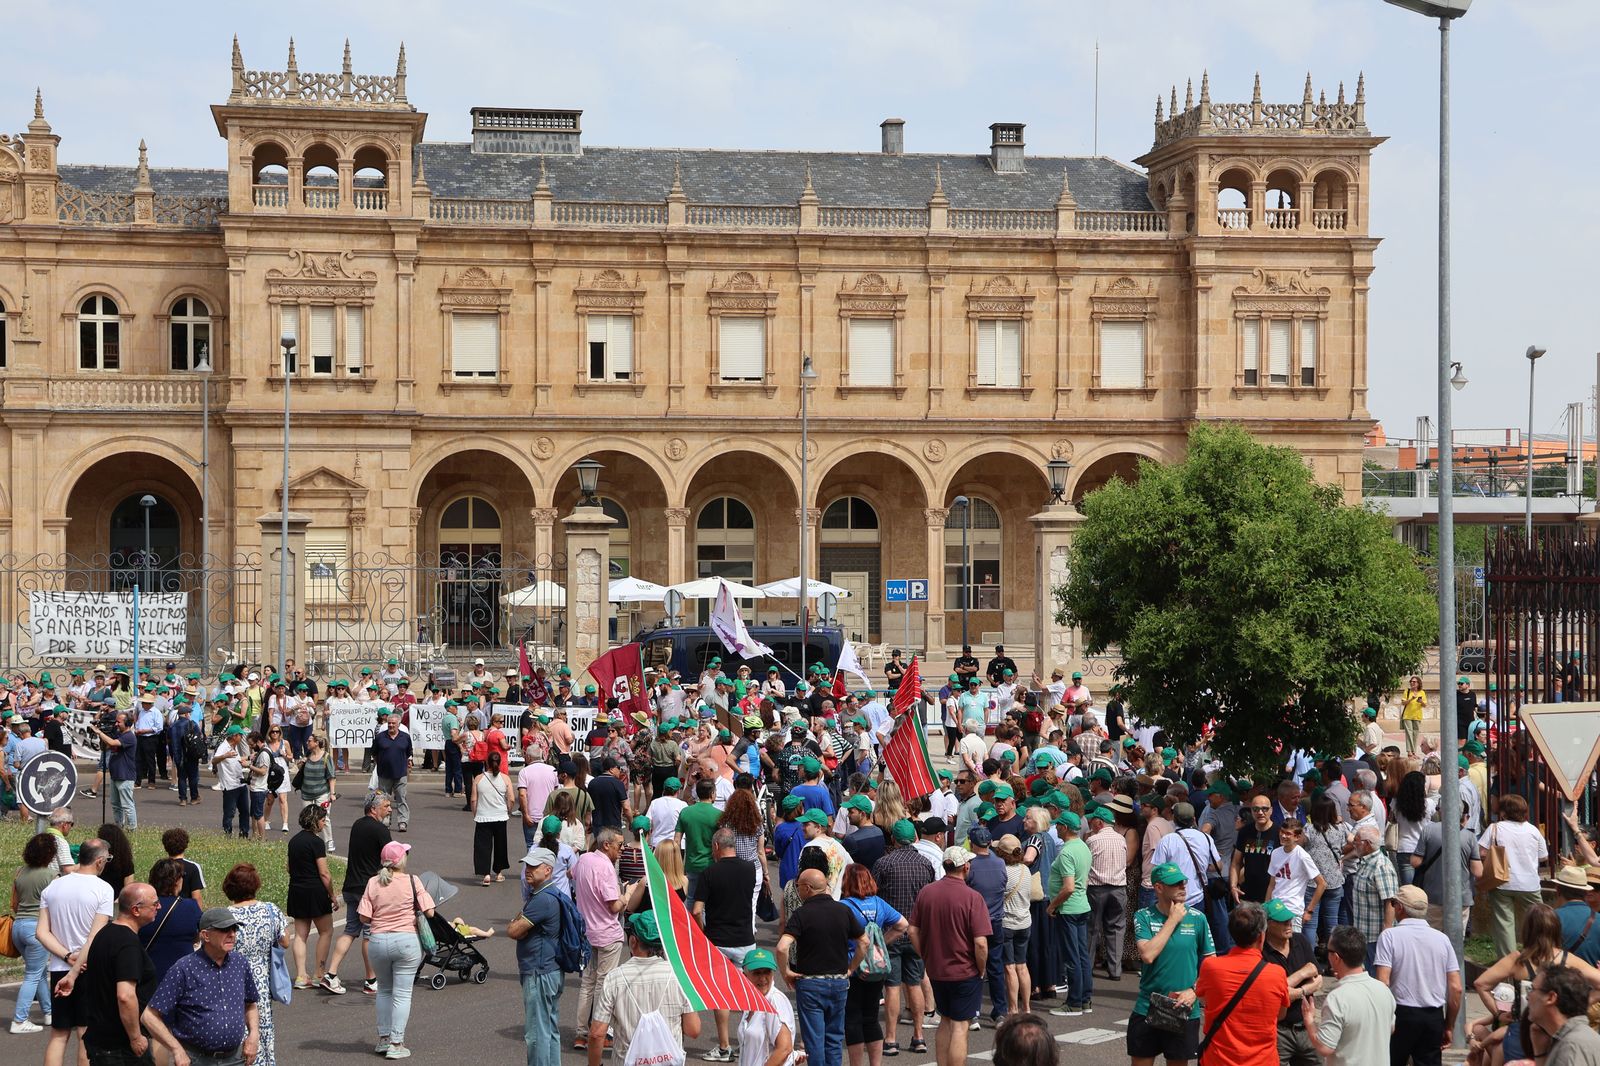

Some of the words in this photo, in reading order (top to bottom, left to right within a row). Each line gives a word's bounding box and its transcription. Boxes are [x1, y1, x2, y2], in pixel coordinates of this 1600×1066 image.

[887, 587, 907, 595] TAXI
[911, 581, 925, 599] P
[75, 591, 110, 604] AVE
[140, 592, 184, 604] PARA
[34, 605, 50, 618] LO
[57, 604, 118, 618] PARAMOS
[34, 618, 122, 637] SANABRIA
[148, 620, 187, 636] LUCHA
[48, 639, 77, 654] POR
[84, 640, 110, 655] SUS
[340, 716, 372, 726] EXIGEN
[416, 709, 430, 720] NO
[571, 717, 588, 731] SIN
[412, 733, 421, 742] DE
